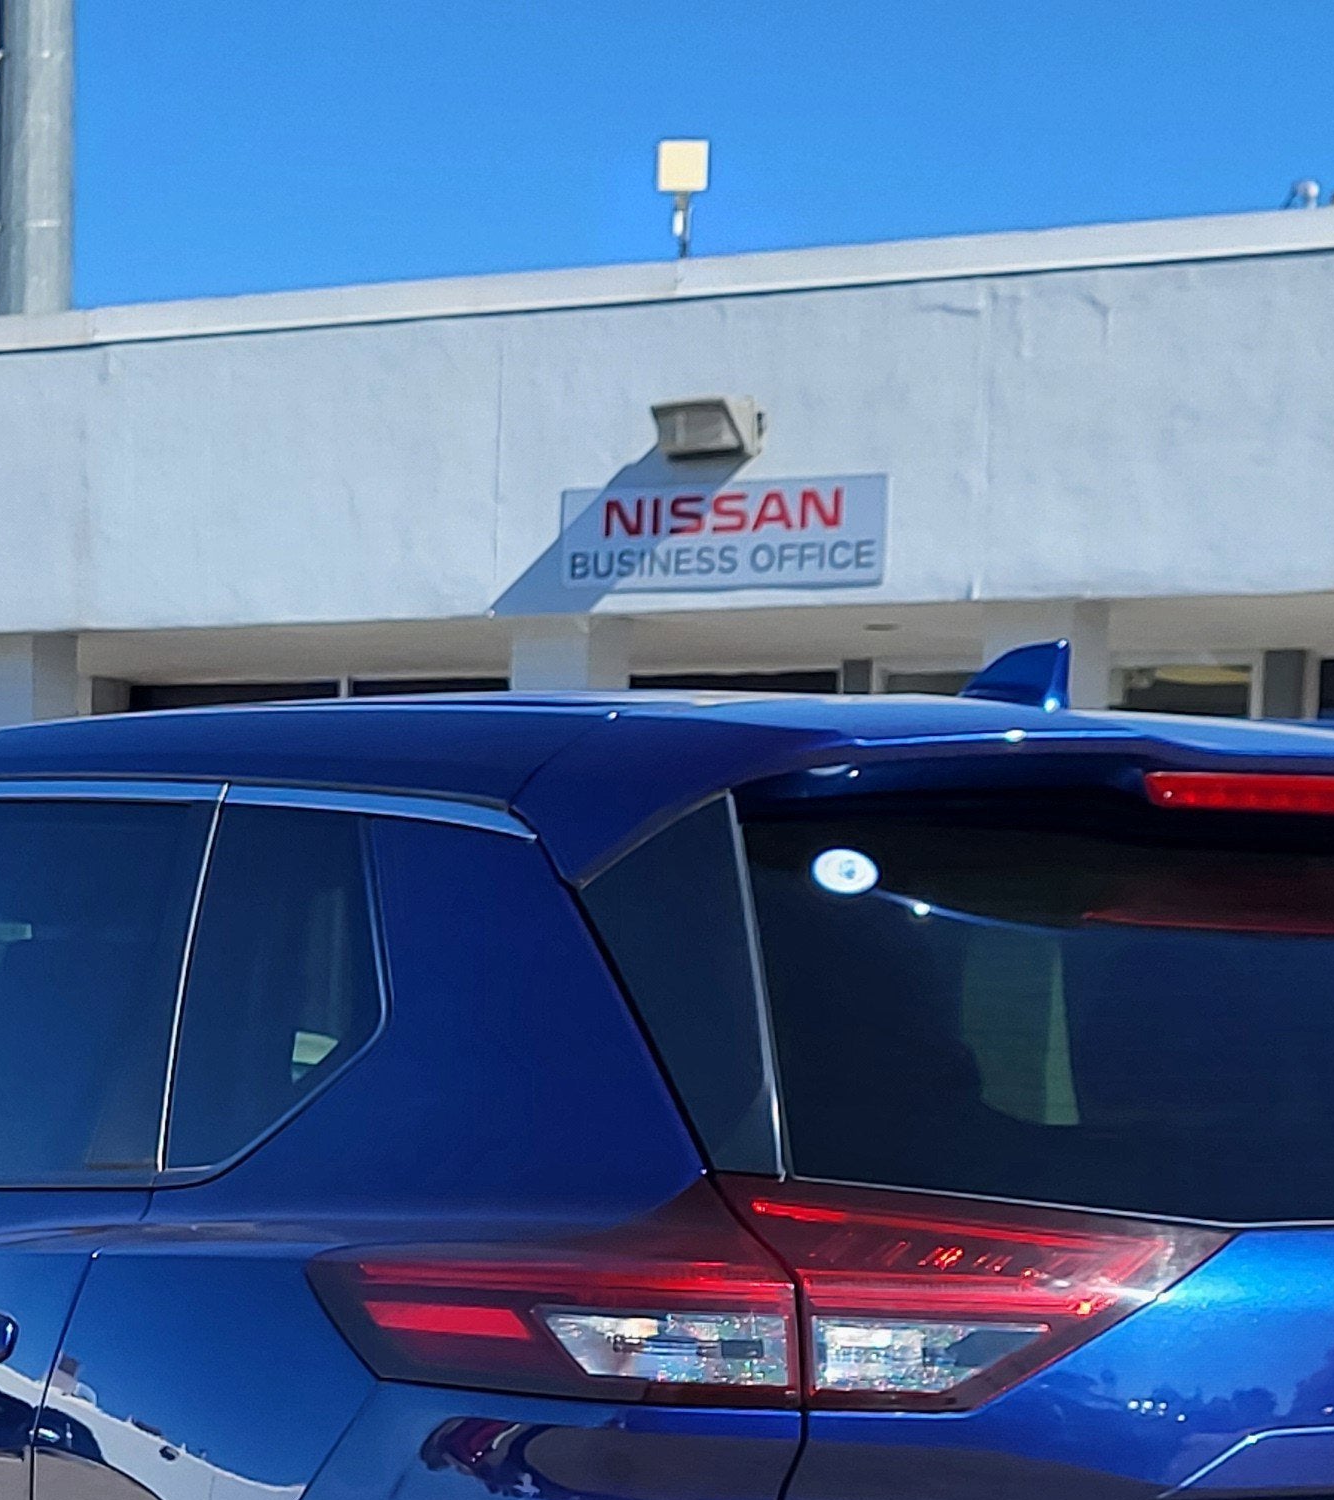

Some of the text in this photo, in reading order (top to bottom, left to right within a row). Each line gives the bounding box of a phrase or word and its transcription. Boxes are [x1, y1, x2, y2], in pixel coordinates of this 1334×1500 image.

[604, 487, 844, 538] NISSAN
[570, 540, 876, 580] BUSINESS OFFICE
